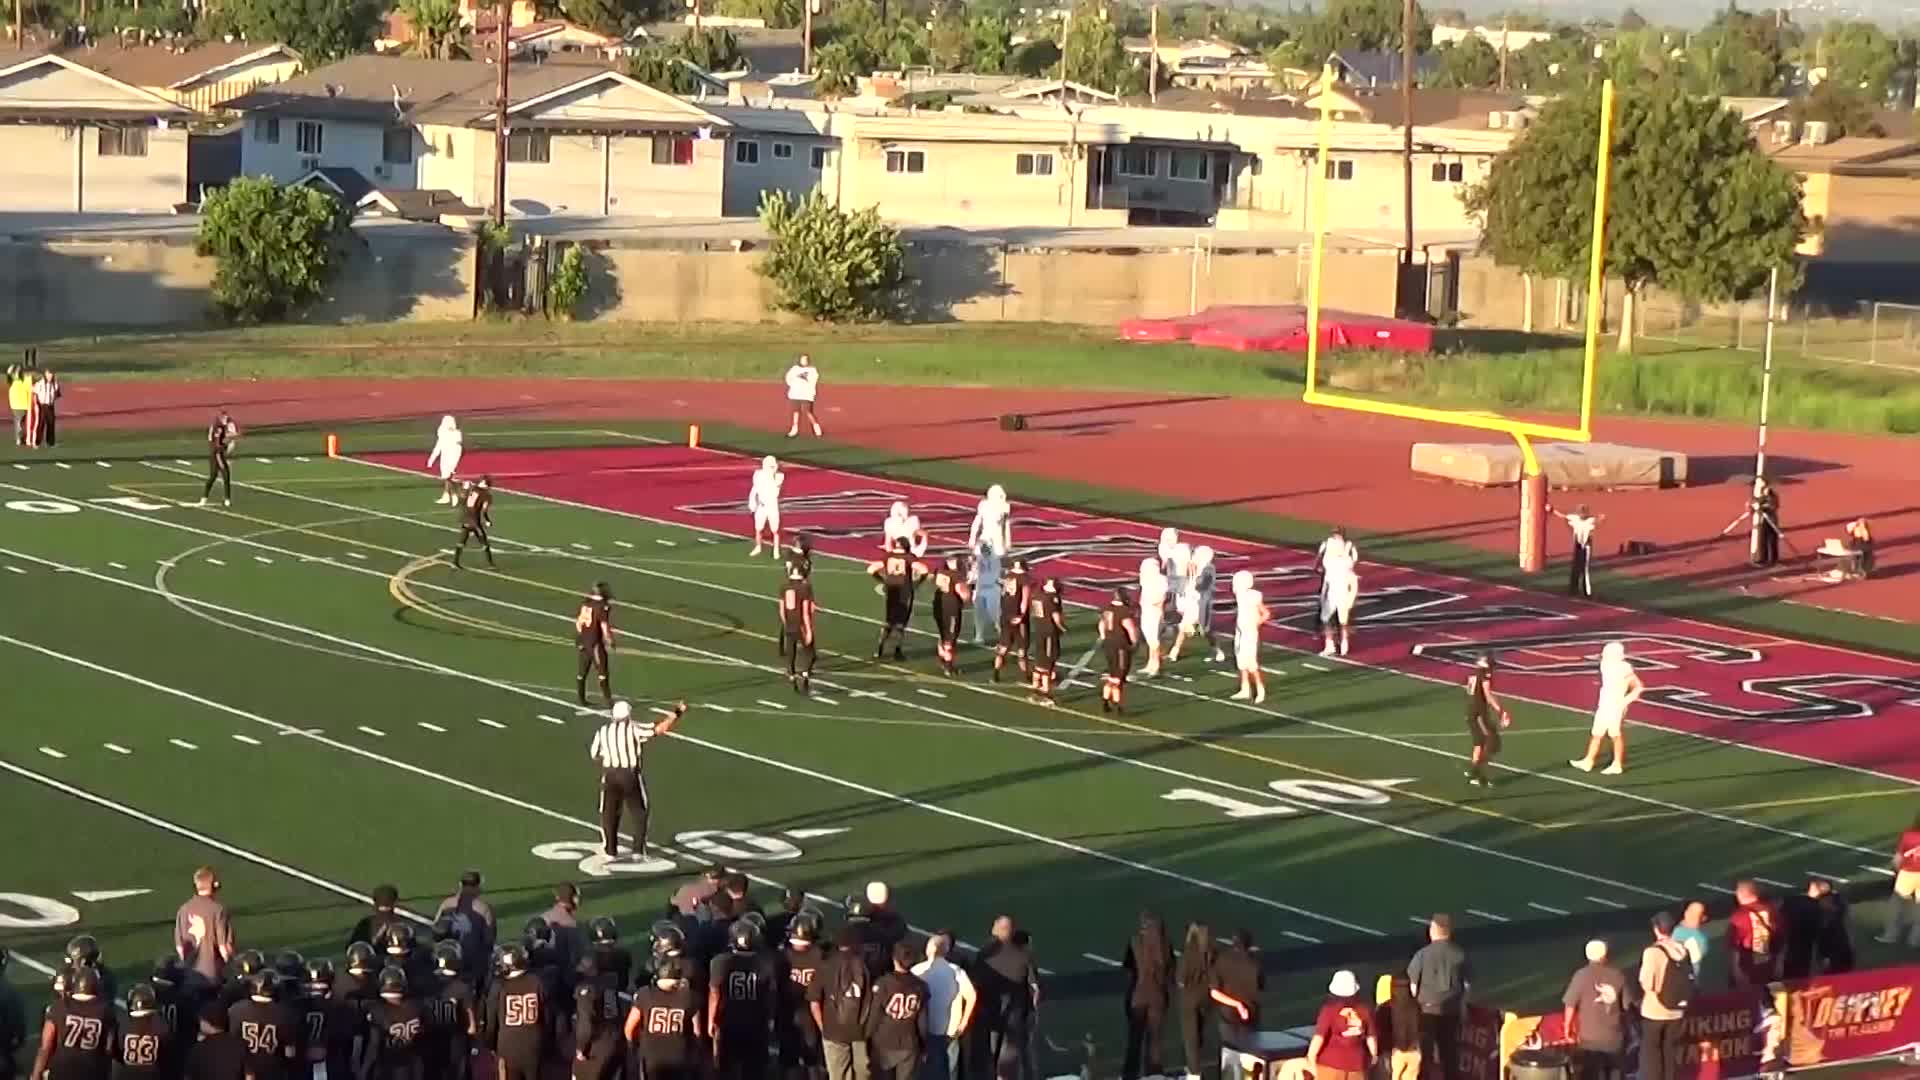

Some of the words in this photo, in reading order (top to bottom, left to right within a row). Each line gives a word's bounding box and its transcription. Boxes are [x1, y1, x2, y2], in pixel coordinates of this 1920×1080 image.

[1160, 779, 1392, 818] 10
[531, 829, 803, 877] 20
[728, 970, 758, 1001] 61
[505, 993, 539, 1026] 56
[64, 1015, 102, 1049] 73
[242, 1021, 279, 1053] 54
[123, 1033, 159, 1065] 83
